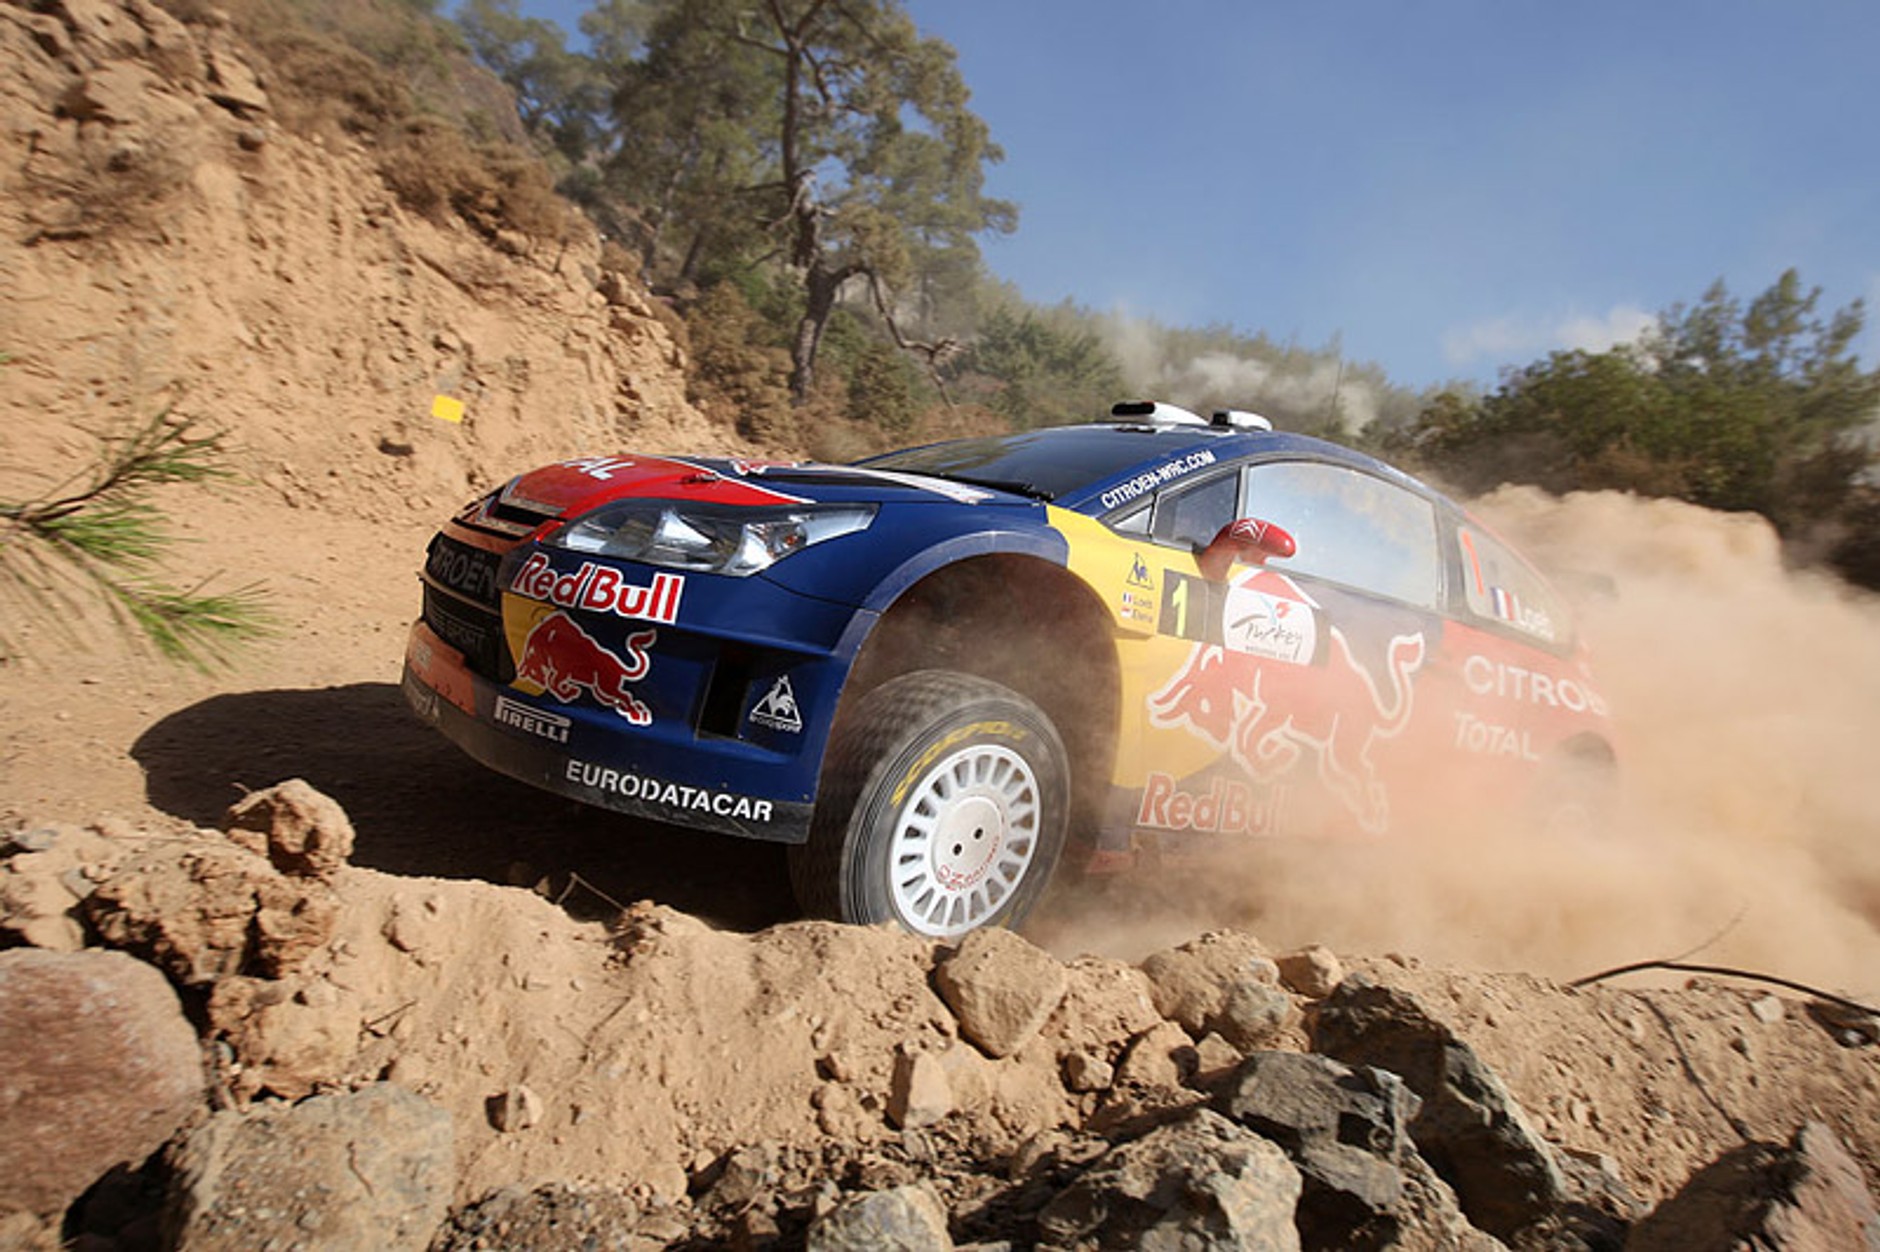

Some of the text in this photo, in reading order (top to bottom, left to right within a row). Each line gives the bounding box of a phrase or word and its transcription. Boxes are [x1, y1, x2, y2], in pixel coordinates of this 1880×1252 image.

[1102, 450, 1216, 509] CITROEN-WRC.COM
[510, 552, 685, 625] Red Bull
[1172, 578, 1188, 638] 1
[494, 695, 571, 743] PIRELLI
[1453, 709, 1541, 762] TOTAL
[565, 759, 773, 822] EURODATACAR
[1137, 771, 1224, 832] Red
